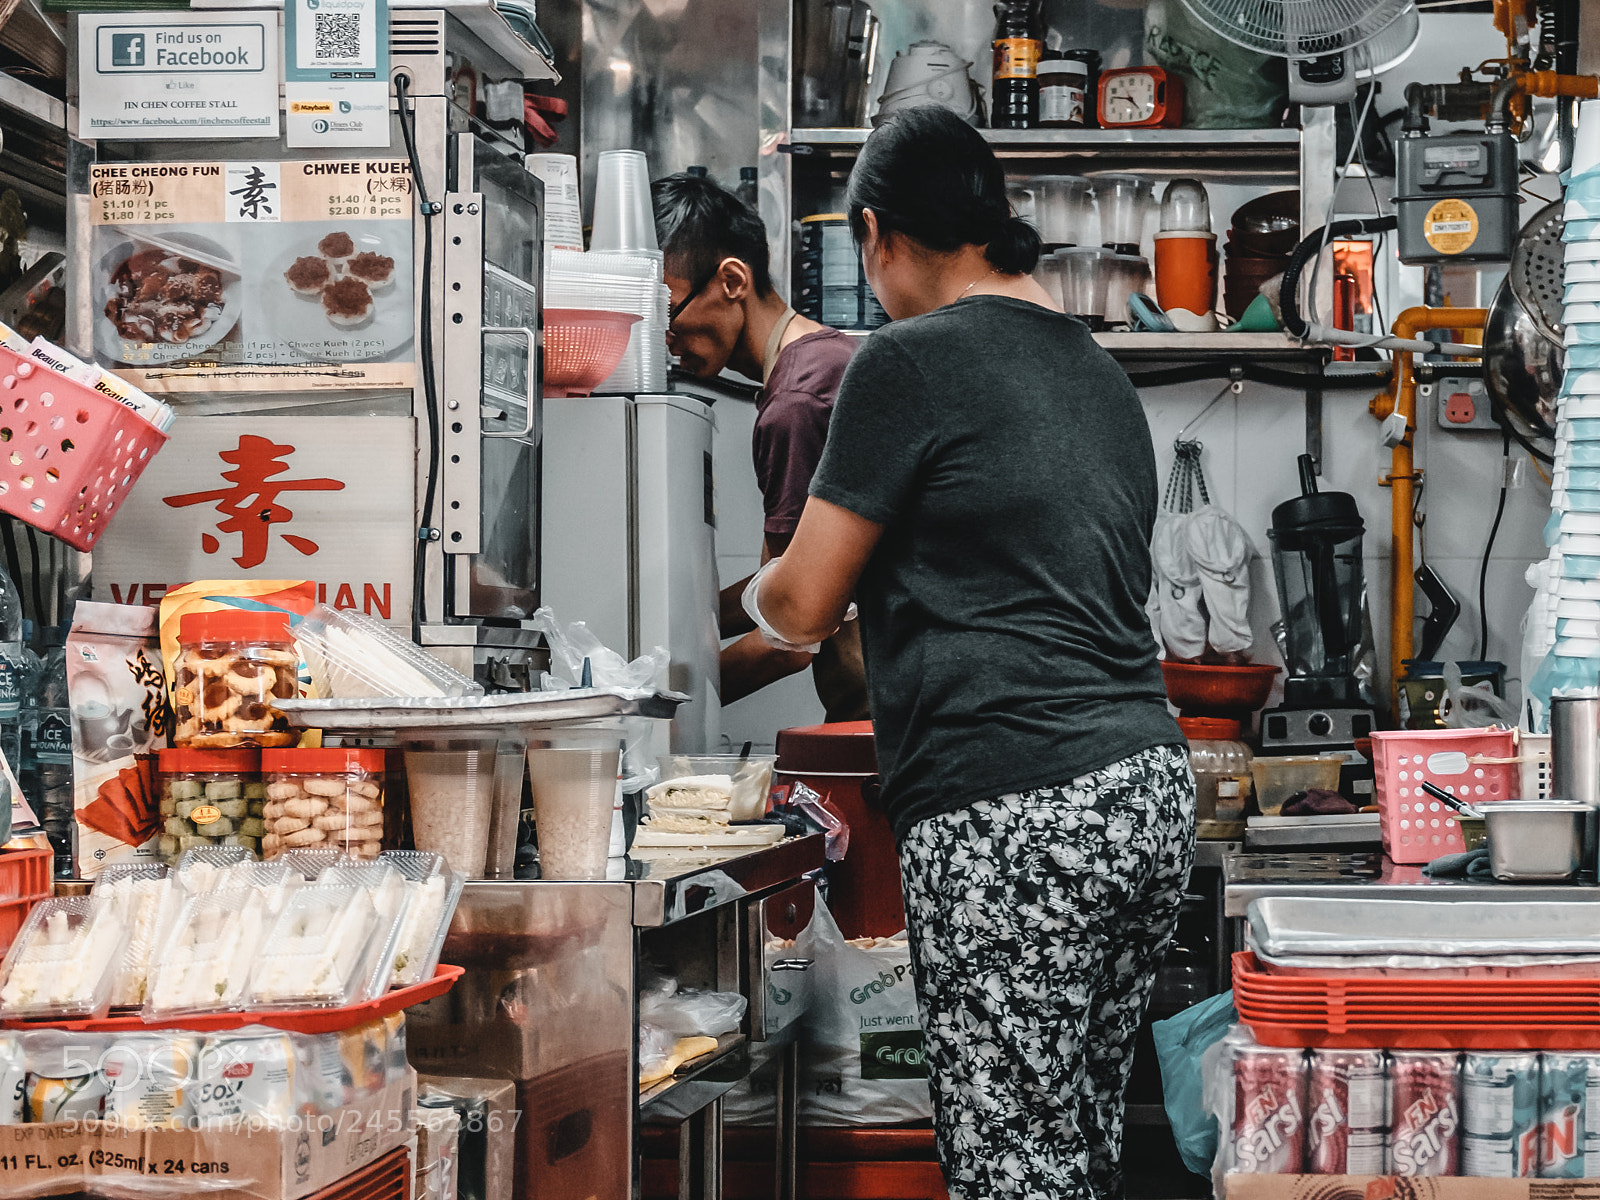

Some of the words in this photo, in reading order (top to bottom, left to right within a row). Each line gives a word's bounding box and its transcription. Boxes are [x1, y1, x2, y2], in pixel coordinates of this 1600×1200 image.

[156, 32, 183, 44] Find
[188, 34, 202, 44] us
[205, 34, 221, 44] on
[157, 46, 249, 65] Facebook
[124, 101, 138, 110] JIN
[141, 101, 168, 109] CHEN
[171, 101, 206, 109] COFFEE
[92, 168, 127, 178] CHEE
[132, 167, 188, 177] CHEONG
[192, 167, 220, 176] FUN
[303, 163, 360, 175] CHWEE
[366, 163, 412, 174] KUEH
[229, 166, 277, 219] 素
[103, 200, 134, 209] $1.10
[145, 200, 150, 208] 1
[154, 201, 168, 210] pc
[329, 195, 359, 204] $1.40
[370, 195, 376, 204] 4
[380, 196, 401, 205] pcs
[103, 211, 134, 221] $1.80
[144, 211, 150, 220] 2
[154, 212, 174, 221] pcs
[329, 206, 359, 216] $2.80
[370, 206, 376, 215] 8
[380, 207, 401, 216] pcs
[260, 342, 275, 351] pc)
[288, 341, 320, 349] Chwee
[352, 340, 360, 348] (2
[363, 339, 385, 348] pcs)
[32, 348, 71, 373] Beautex
[243, 351, 253, 359] (2
[256, 351, 277, 360] pcs)
[290, 350, 322, 358] Chwee
[353, 349, 361, 357] (2
[365, 349, 386, 358] pcs)
[95, 381, 142, 411] Beautex
[162, 434, 345, 569] 素
[0, 672, 13, 685] CE
[44, 729, 62, 740] ICE
[860, 1016, 882, 1029] Just
[886, 1015, 914, 1026] went
[1, 1155, 17, 1170] 11
[25, 1155, 52, 1169] FL.
[57, 1154, 83, 1167] oz.
[149, 1162, 158, 1174] x
[164, 1159, 185, 1174] 24
[191, 1162, 230, 1173] cans
